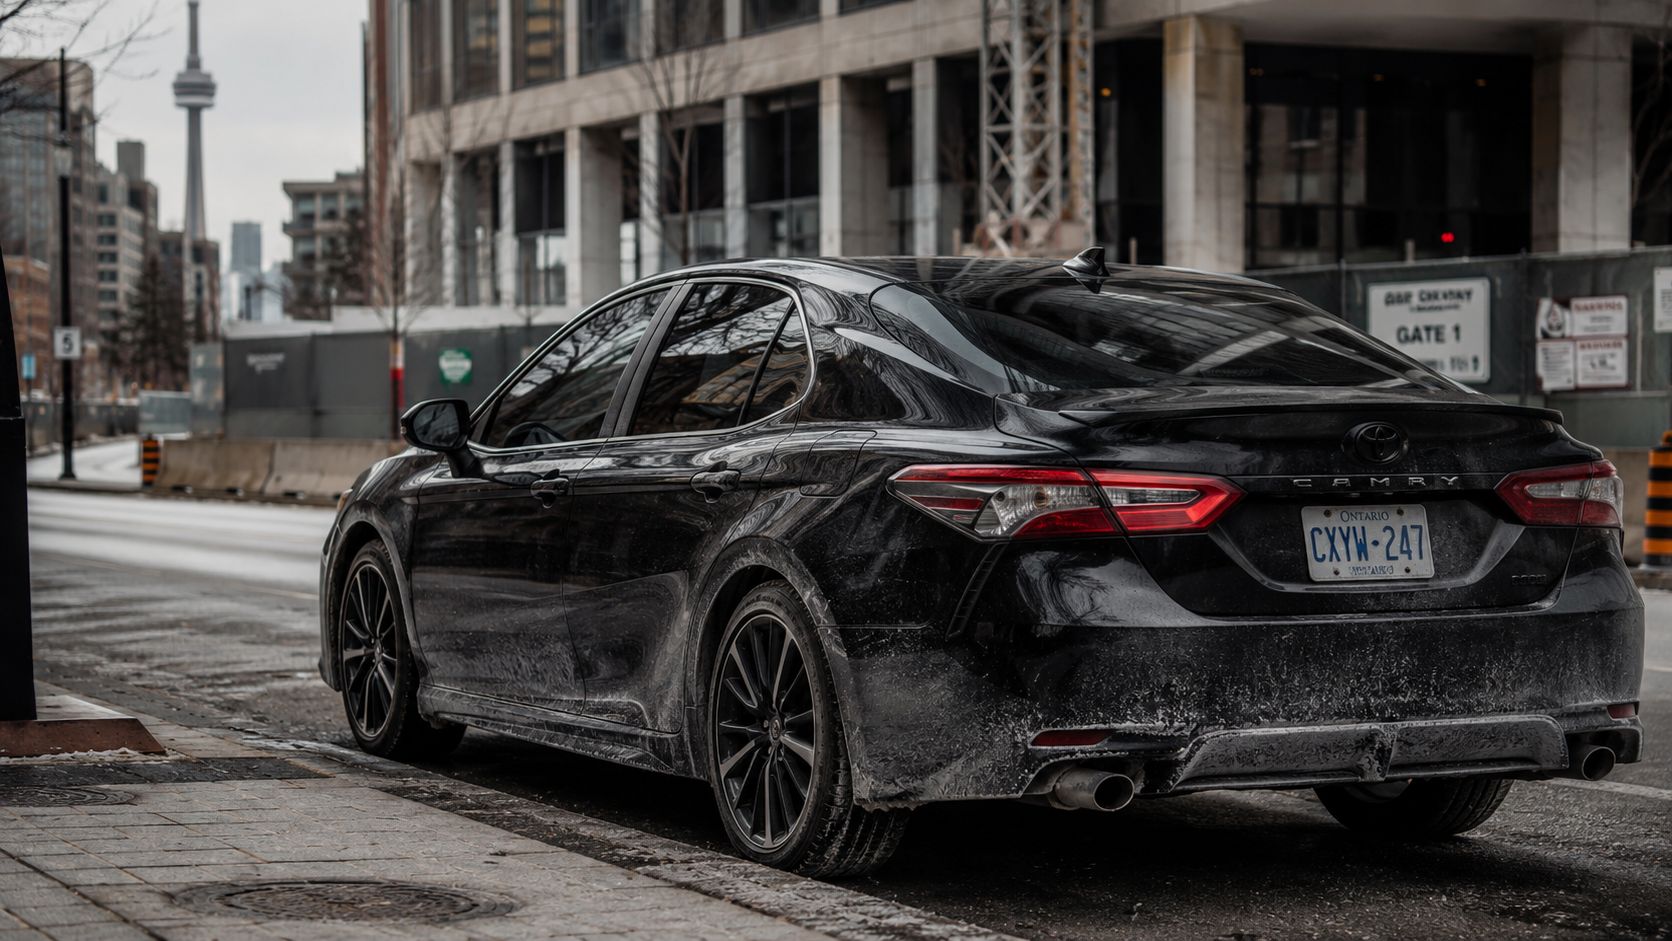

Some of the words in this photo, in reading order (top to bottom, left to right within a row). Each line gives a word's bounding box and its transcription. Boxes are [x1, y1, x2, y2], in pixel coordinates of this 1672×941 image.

[1396, 324, 1446, 344] GATE
[1453, 324, 1461, 341] 1
[63, 333, 74, 354] 5
[1293, 476, 1459, 488] CAMRY
[1340, 510, 1390, 522] ONTARIO
